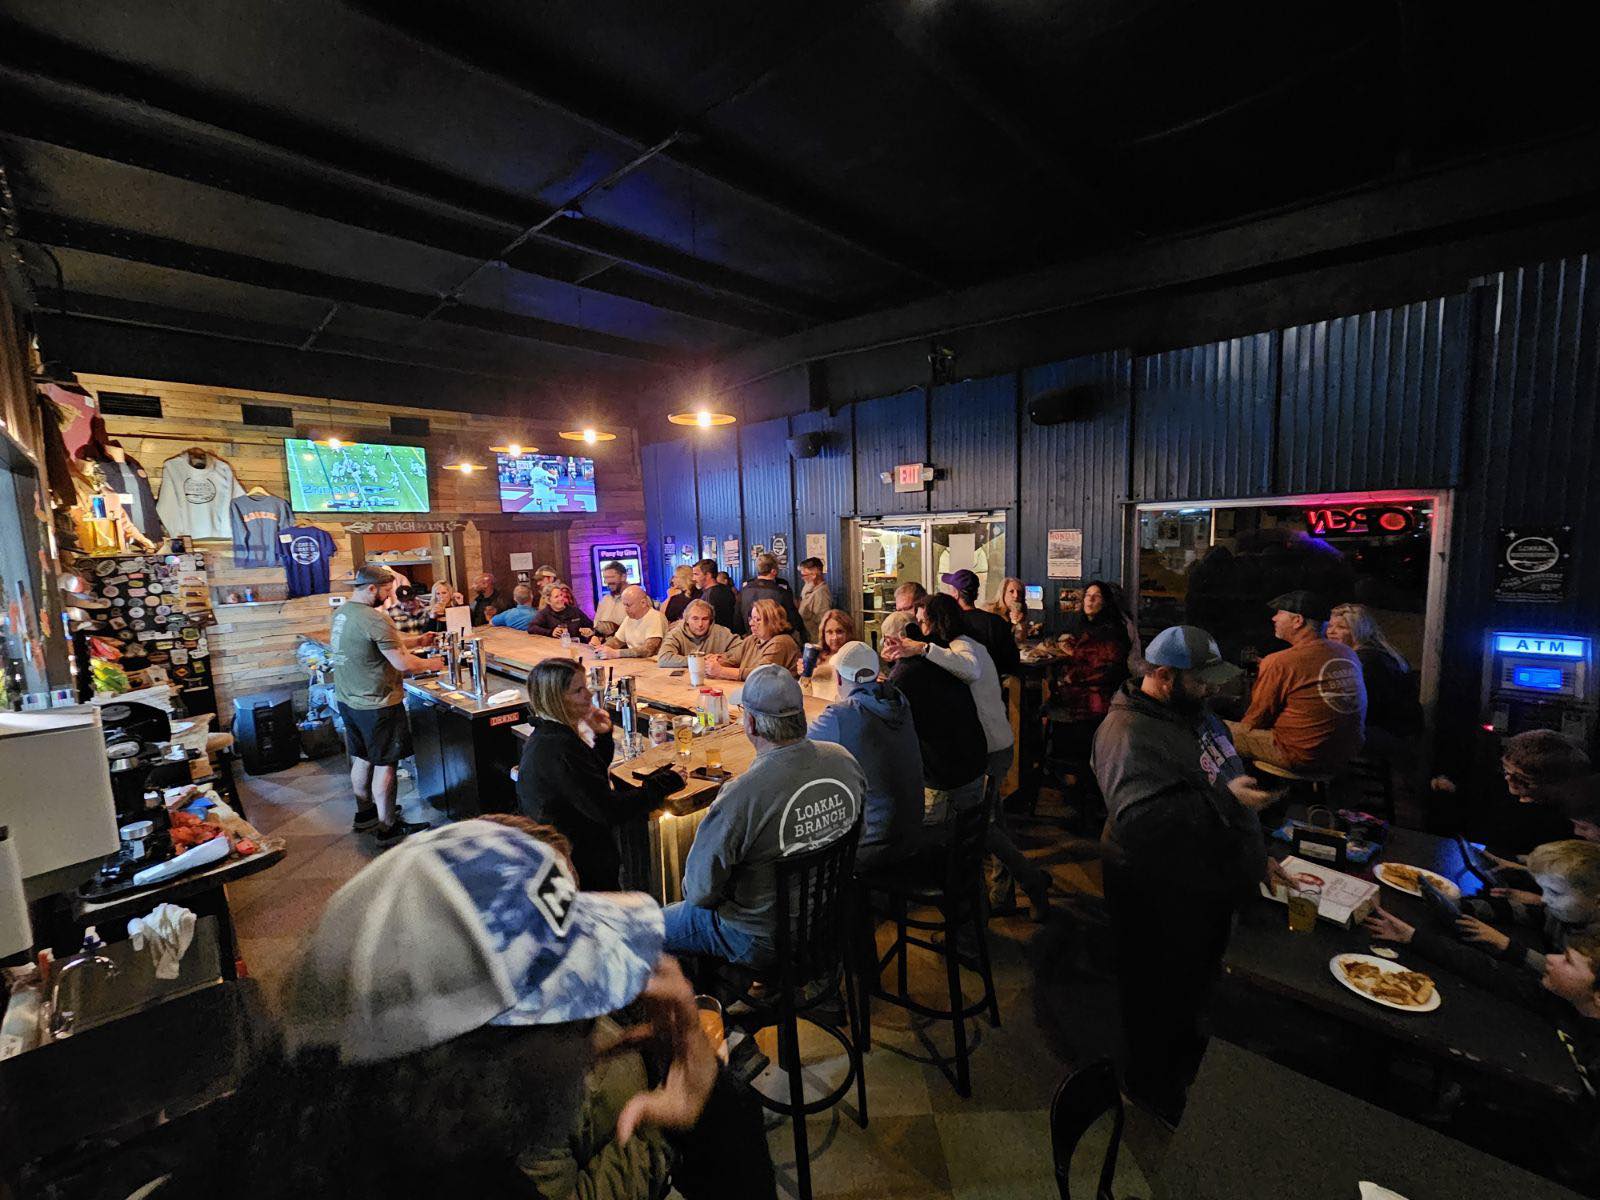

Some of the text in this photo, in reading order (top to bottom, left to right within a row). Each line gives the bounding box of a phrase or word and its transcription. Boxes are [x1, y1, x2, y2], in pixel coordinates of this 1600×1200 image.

[900, 466, 919, 484] EXIT
[1516, 639, 1565, 653] ATM
[794, 794, 843, 822] LOAKAL
[794, 806, 846, 838] BRANCH
